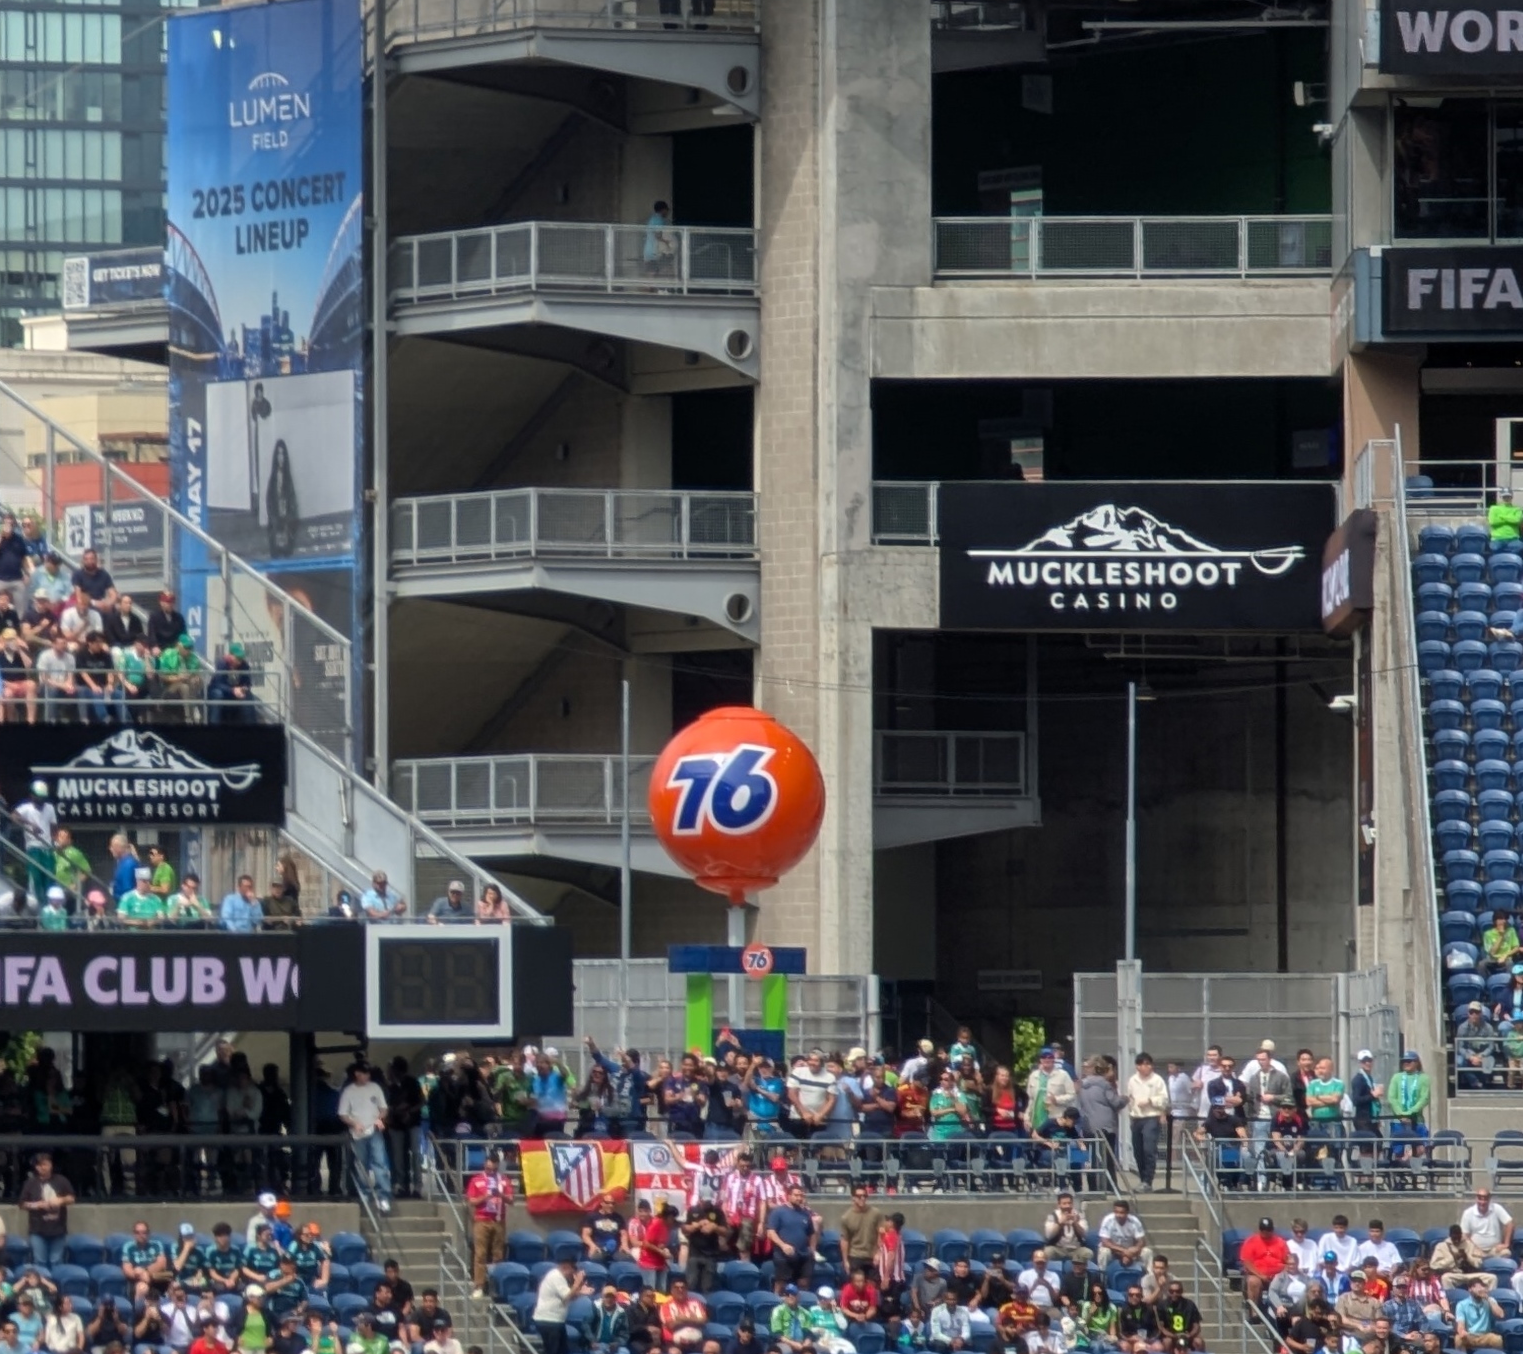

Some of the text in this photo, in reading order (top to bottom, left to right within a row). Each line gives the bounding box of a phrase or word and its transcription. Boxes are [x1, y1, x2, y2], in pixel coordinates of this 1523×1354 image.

[230, 92, 311, 128] LUMEN
[252, 130, 289, 151] FIELD
[192, 171, 347, 220] 2025 CONCERT
[235, 218, 310, 255] LINEUP
[1407, 267, 1523, 311] FIFA
[987, 562, 1242, 586] MUCKLESHOOT
[1049, 592, 1178, 610] CASINO
[57, 778, 221, 801] MUCKLESHOOT
[667, 743, 778, 835] 76
[57, 803, 221, 818] CASINO RESORT
[747, 952, 767, 969] 76
[83, 955, 226, 1005] CLUB
